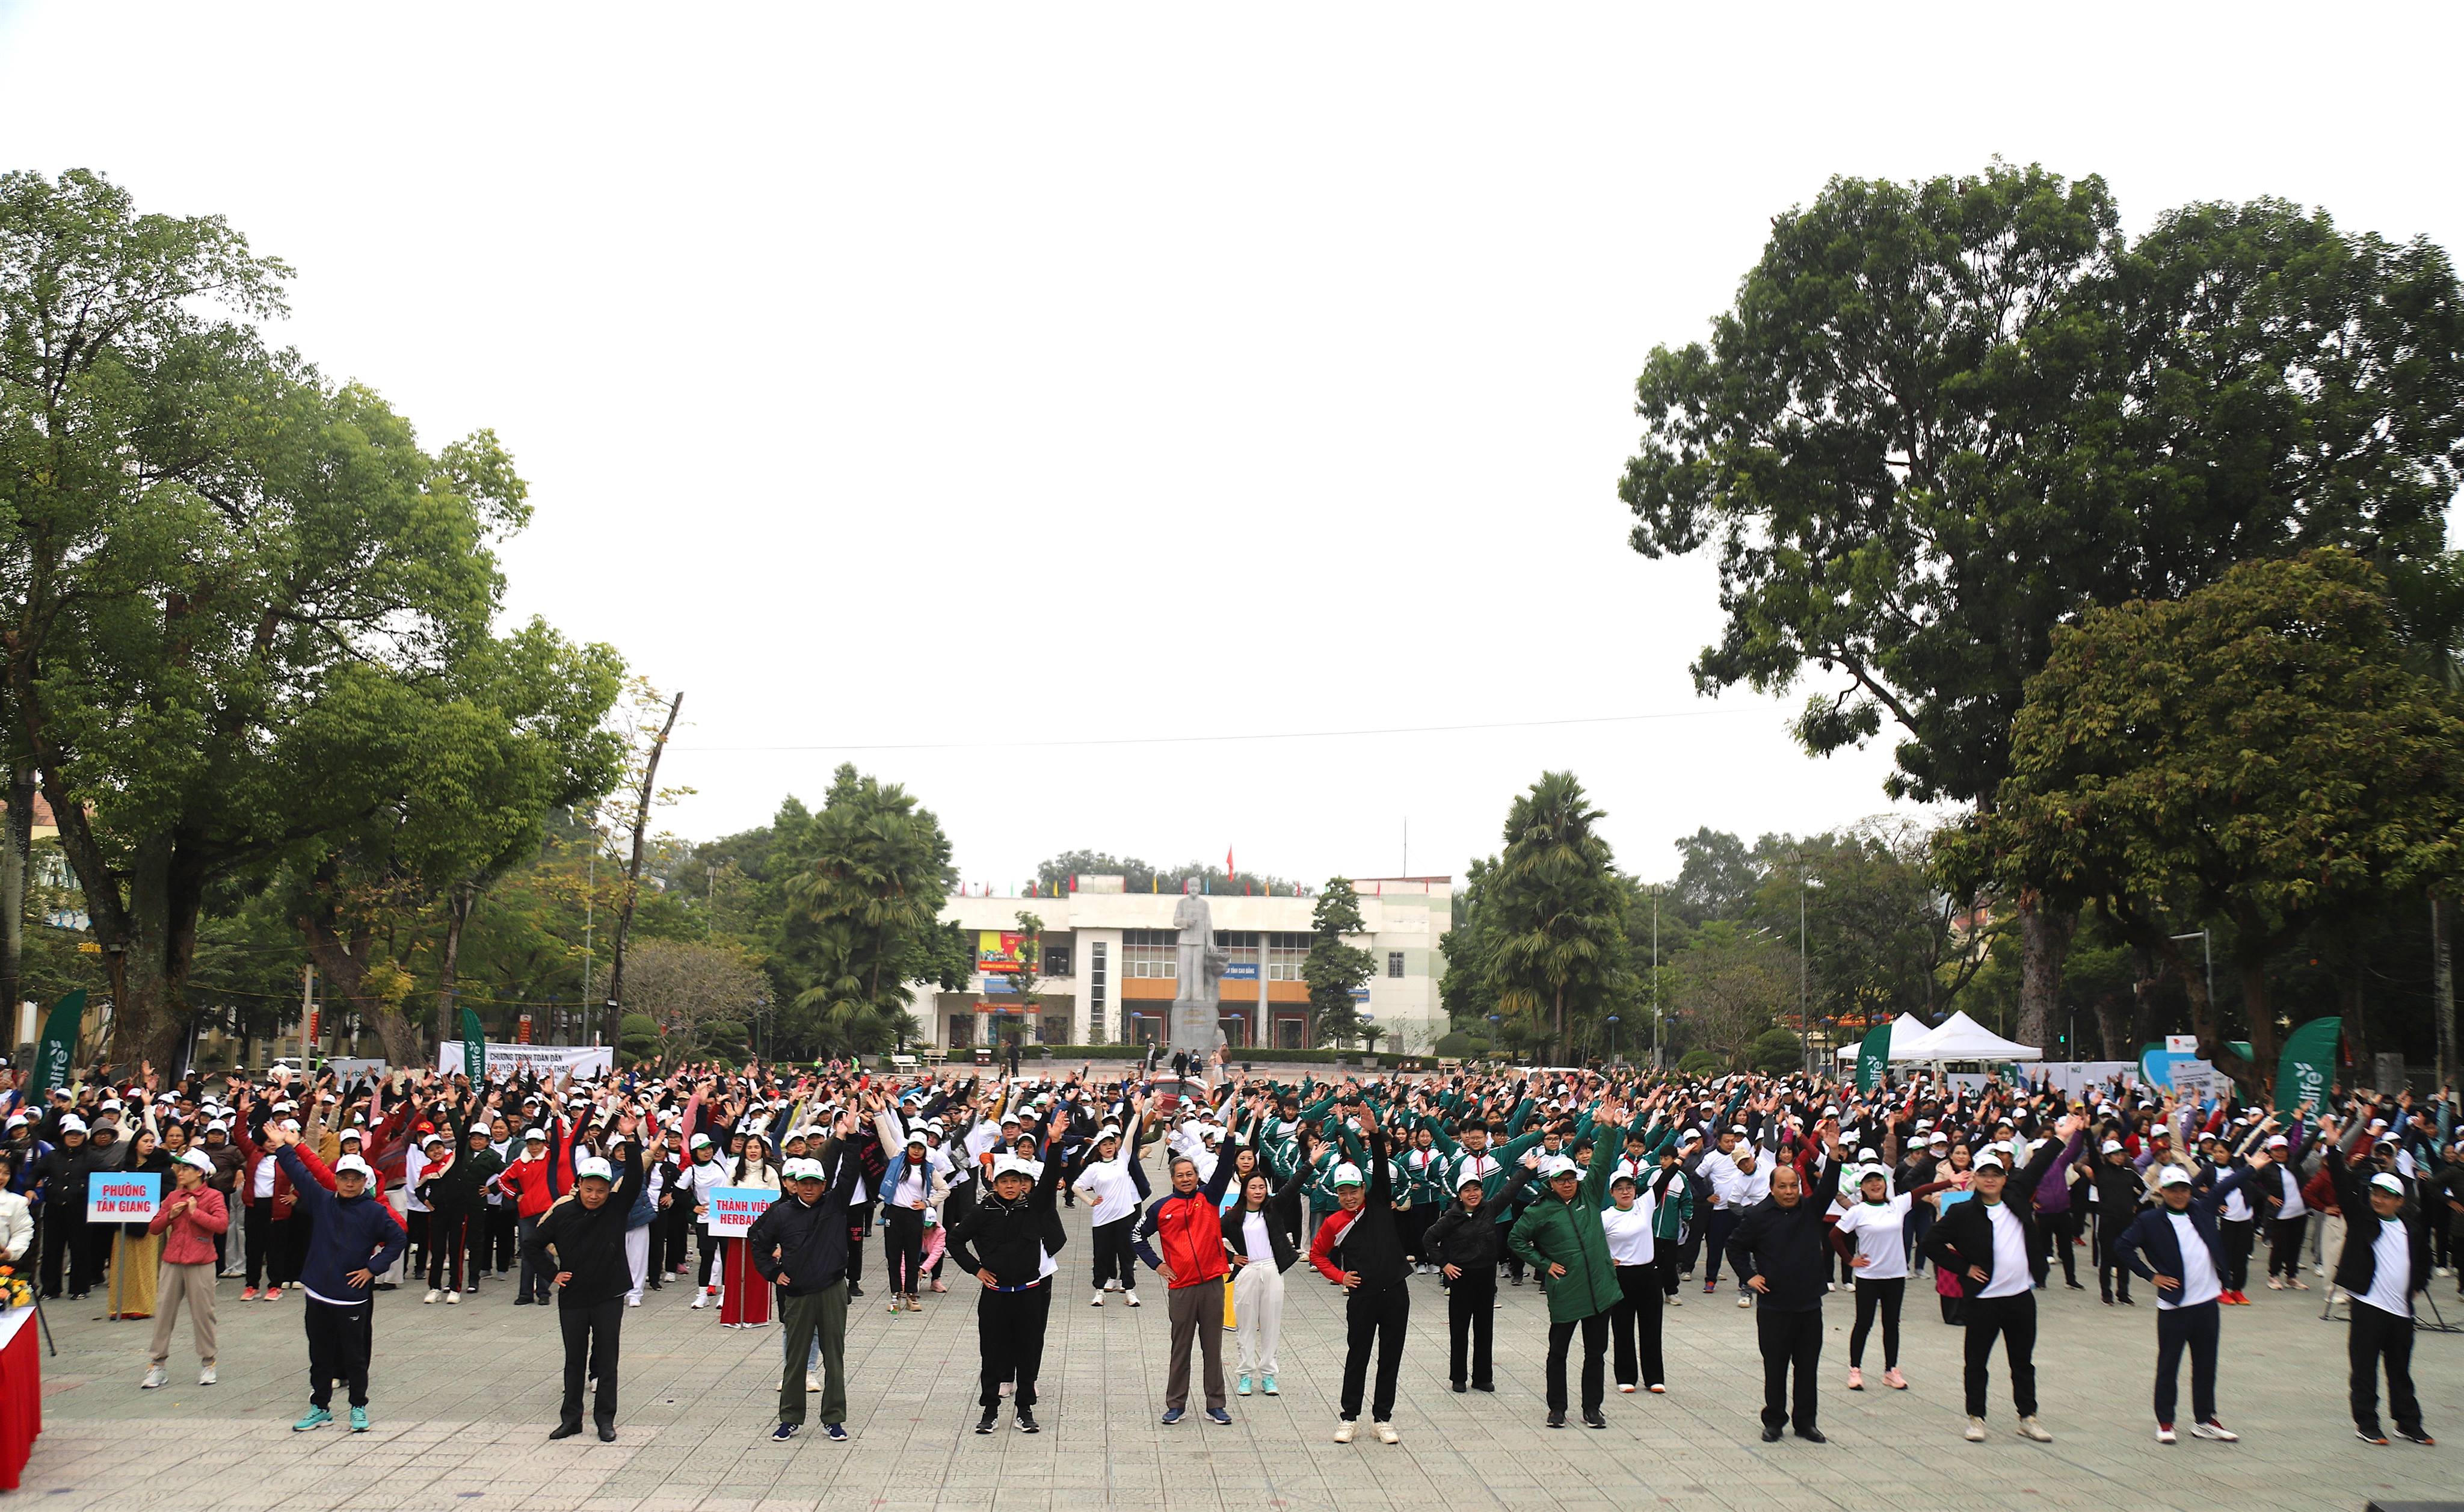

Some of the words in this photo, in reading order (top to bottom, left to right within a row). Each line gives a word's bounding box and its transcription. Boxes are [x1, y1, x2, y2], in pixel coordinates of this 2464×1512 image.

[103, 1182, 146, 1196] PHƯỜNG
[97, 1197, 115, 1212] TÂN
[119, 1200, 150, 1212] GIANG
[716, 1197, 748, 1211] THÀNH
